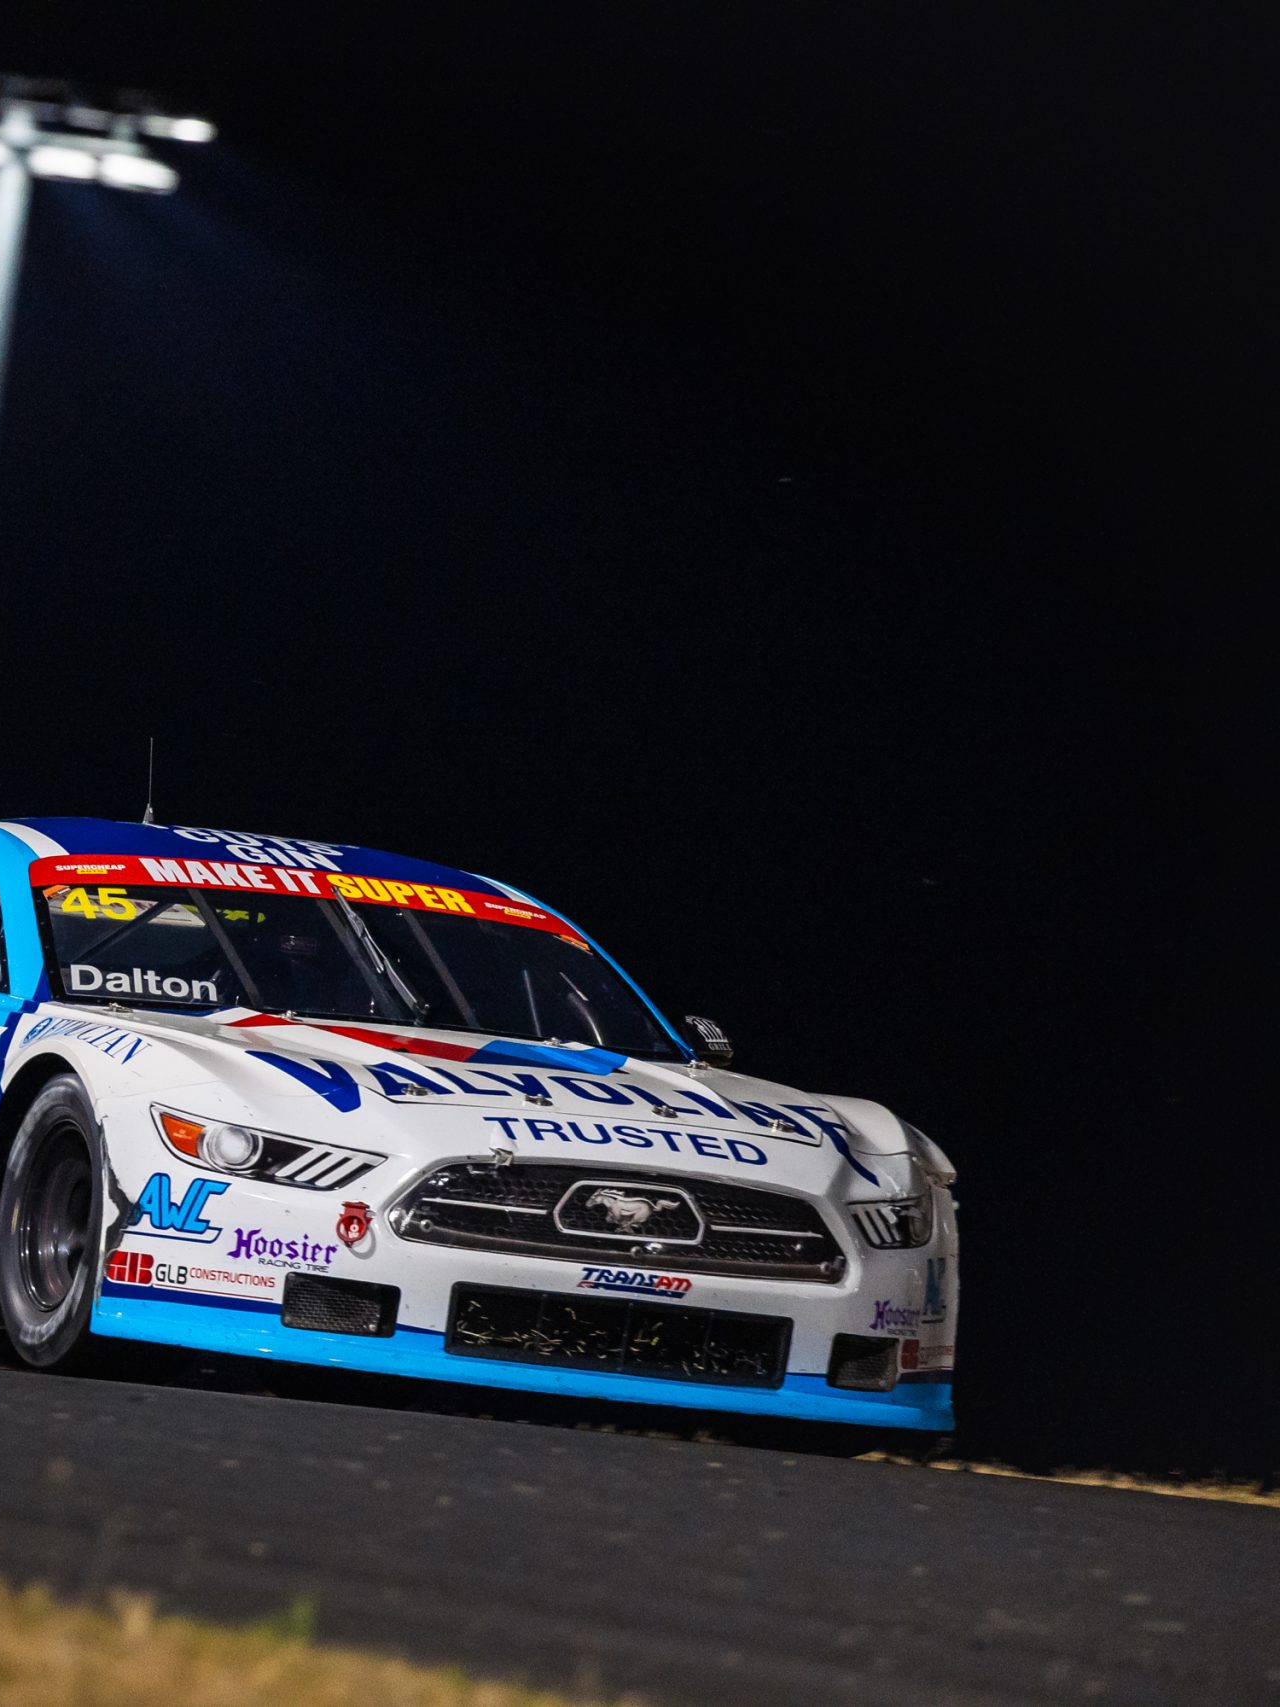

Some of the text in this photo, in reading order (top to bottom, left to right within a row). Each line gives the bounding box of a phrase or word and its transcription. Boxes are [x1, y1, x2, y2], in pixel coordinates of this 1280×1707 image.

[54, 864, 127, 872] SUPERCHEAP
[226, 844, 343, 872] GIN
[138, 857, 476, 914] MAKE IT SUPER
[60, 887, 138, 921] 45
[70, 963, 219, 1002] Dalton
[244, 1049, 880, 1188] VALVOLINE
[483, 1116, 769, 1167] TRUSTED
[226, 1227, 338, 1265] Hoosier
[155, 1263, 276, 1288] GLB CONSTRUCTIONS
[257, 1257, 330, 1274] RACING TIRE
